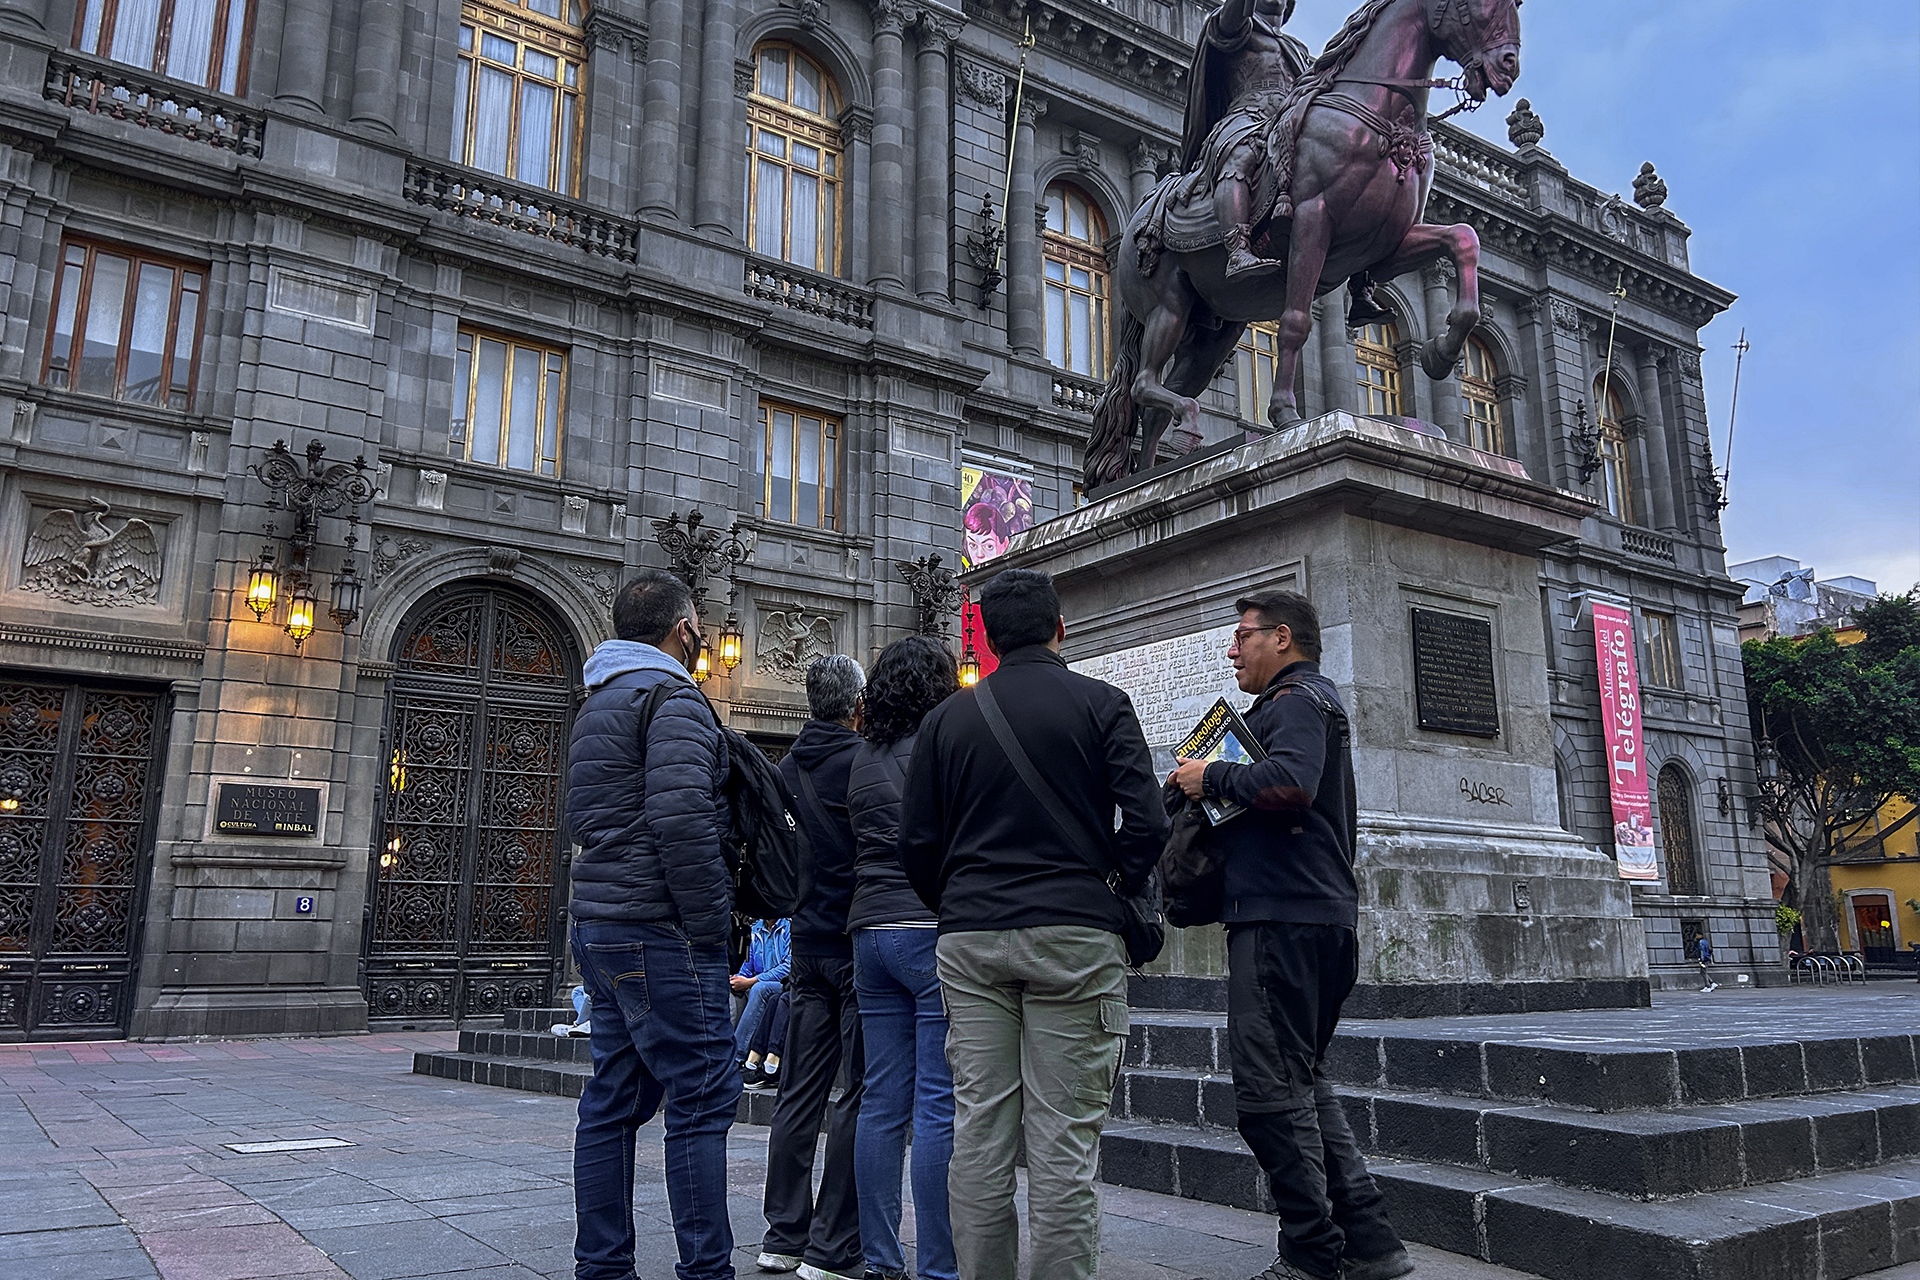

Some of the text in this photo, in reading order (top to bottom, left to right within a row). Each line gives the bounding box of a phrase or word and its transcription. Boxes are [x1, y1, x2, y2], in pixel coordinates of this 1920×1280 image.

[963, 473, 974, 484] 40
[1149, 641, 1175, 655] AGOSTO
[1177, 638, 1187, 648] DE
[1150, 652, 1168, 664] ESTA
[1599, 629, 1613, 699] Museo del
[1168, 659, 1186, 671] PESO
[1610, 629, 1637, 785] Telégrafo
[1177, 704, 1227, 757] arqueología
[1205, 737, 1215, 746] DE
[245, 787, 297, 799] MUSEO
[230, 797, 308, 812] NACIONAL
[233, 810, 303, 823] DE ARTE
[227, 821, 257, 829] CULTURA
[283, 823, 314, 832] INBAL
[300, 897, 311, 911] 8
